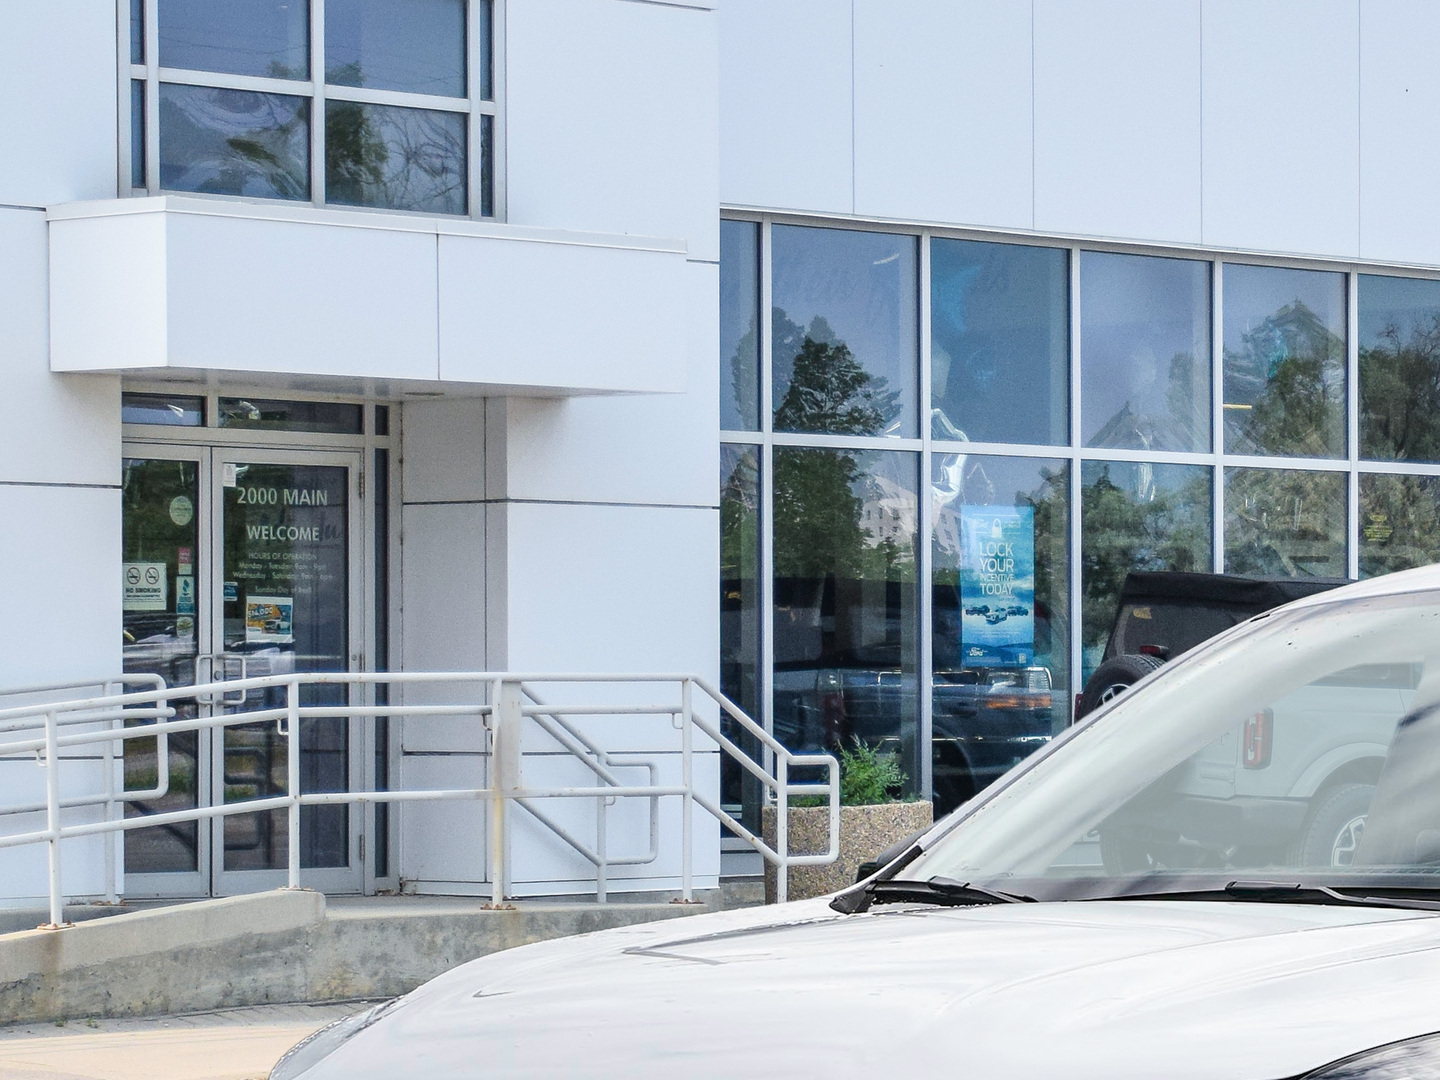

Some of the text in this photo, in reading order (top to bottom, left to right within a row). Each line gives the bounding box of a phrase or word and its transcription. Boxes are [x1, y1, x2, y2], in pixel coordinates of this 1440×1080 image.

[237, 487, 328, 506] 2000 MAIN
[246, 525, 320, 541] WELCOME
[980, 541, 1014, 557] LOCK
[980, 558, 1015, 572] YOUR
[980, 583, 1014, 595] TODAY
